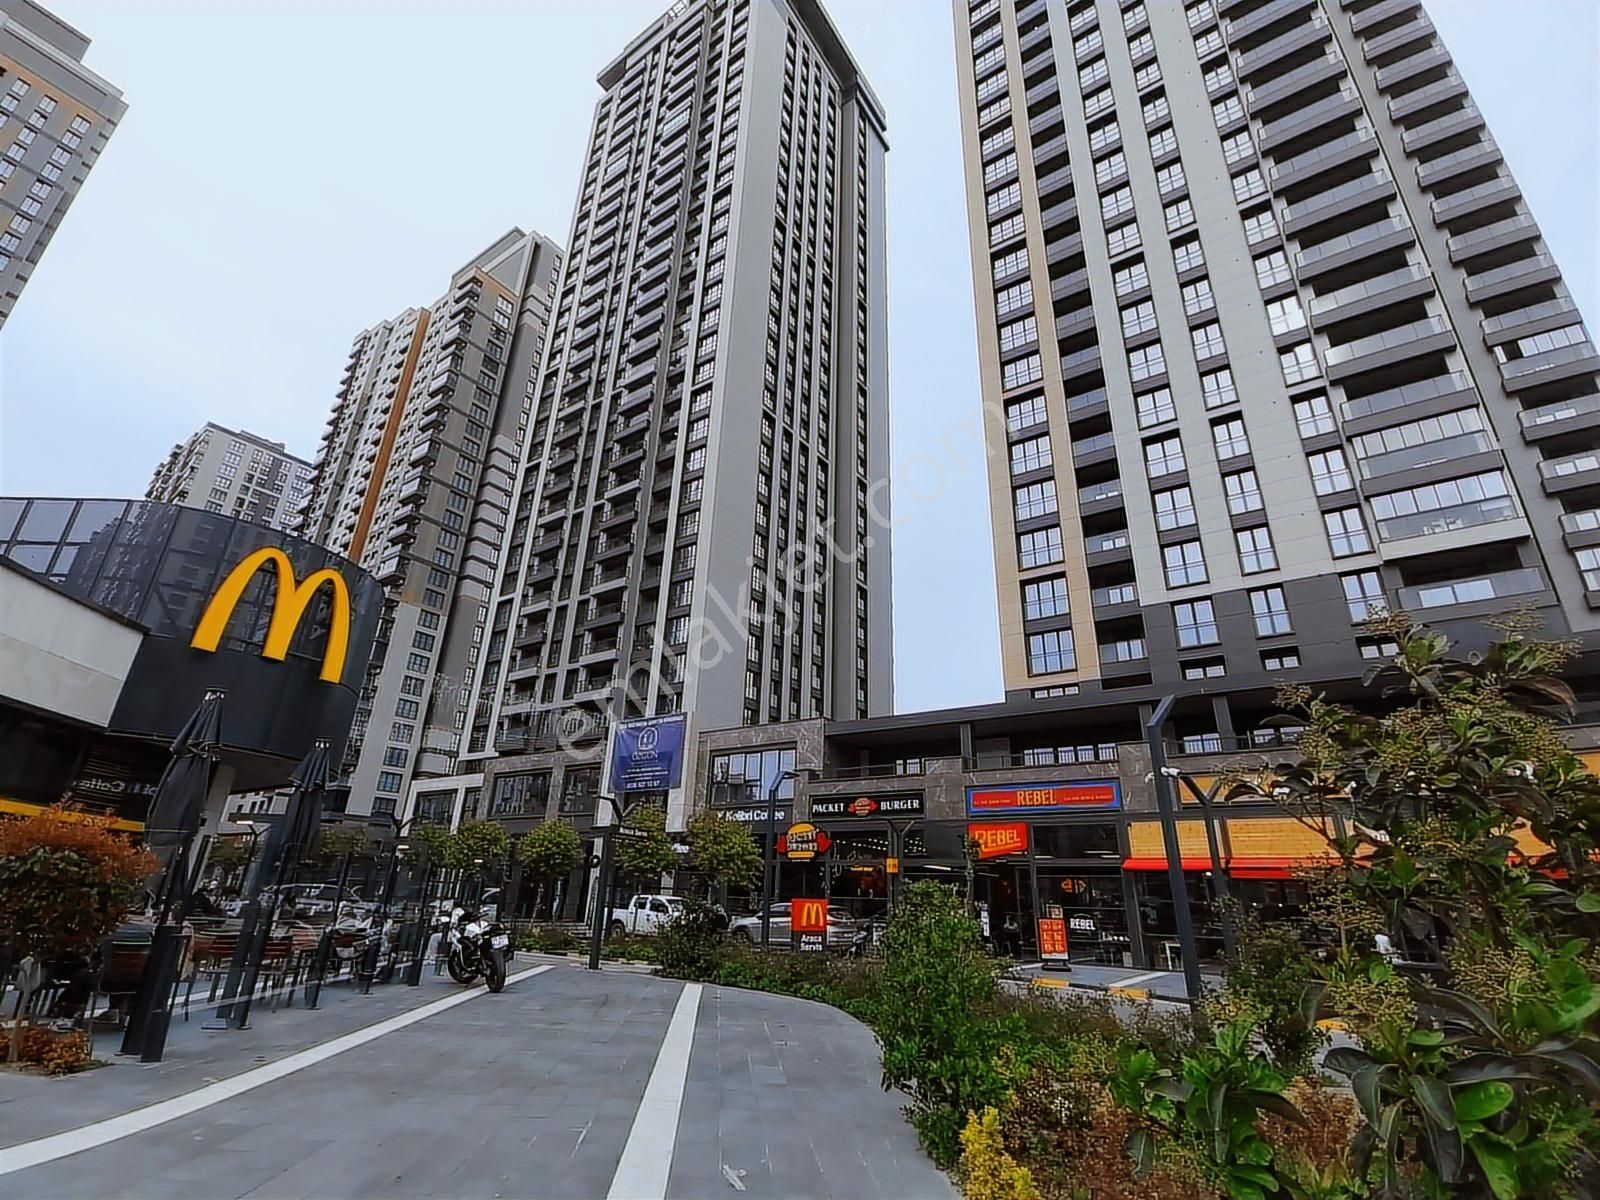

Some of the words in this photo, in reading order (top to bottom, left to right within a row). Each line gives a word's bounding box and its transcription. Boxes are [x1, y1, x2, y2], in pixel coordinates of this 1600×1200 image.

[1016, 789, 1057, 807] REBEL
[812, 803, 844, 813] PACKET
[880, 800, 920, 811] BURGER
[975, 829, 1021, 849] REBEL
[1070, 918, 1096, 931] REBEL
